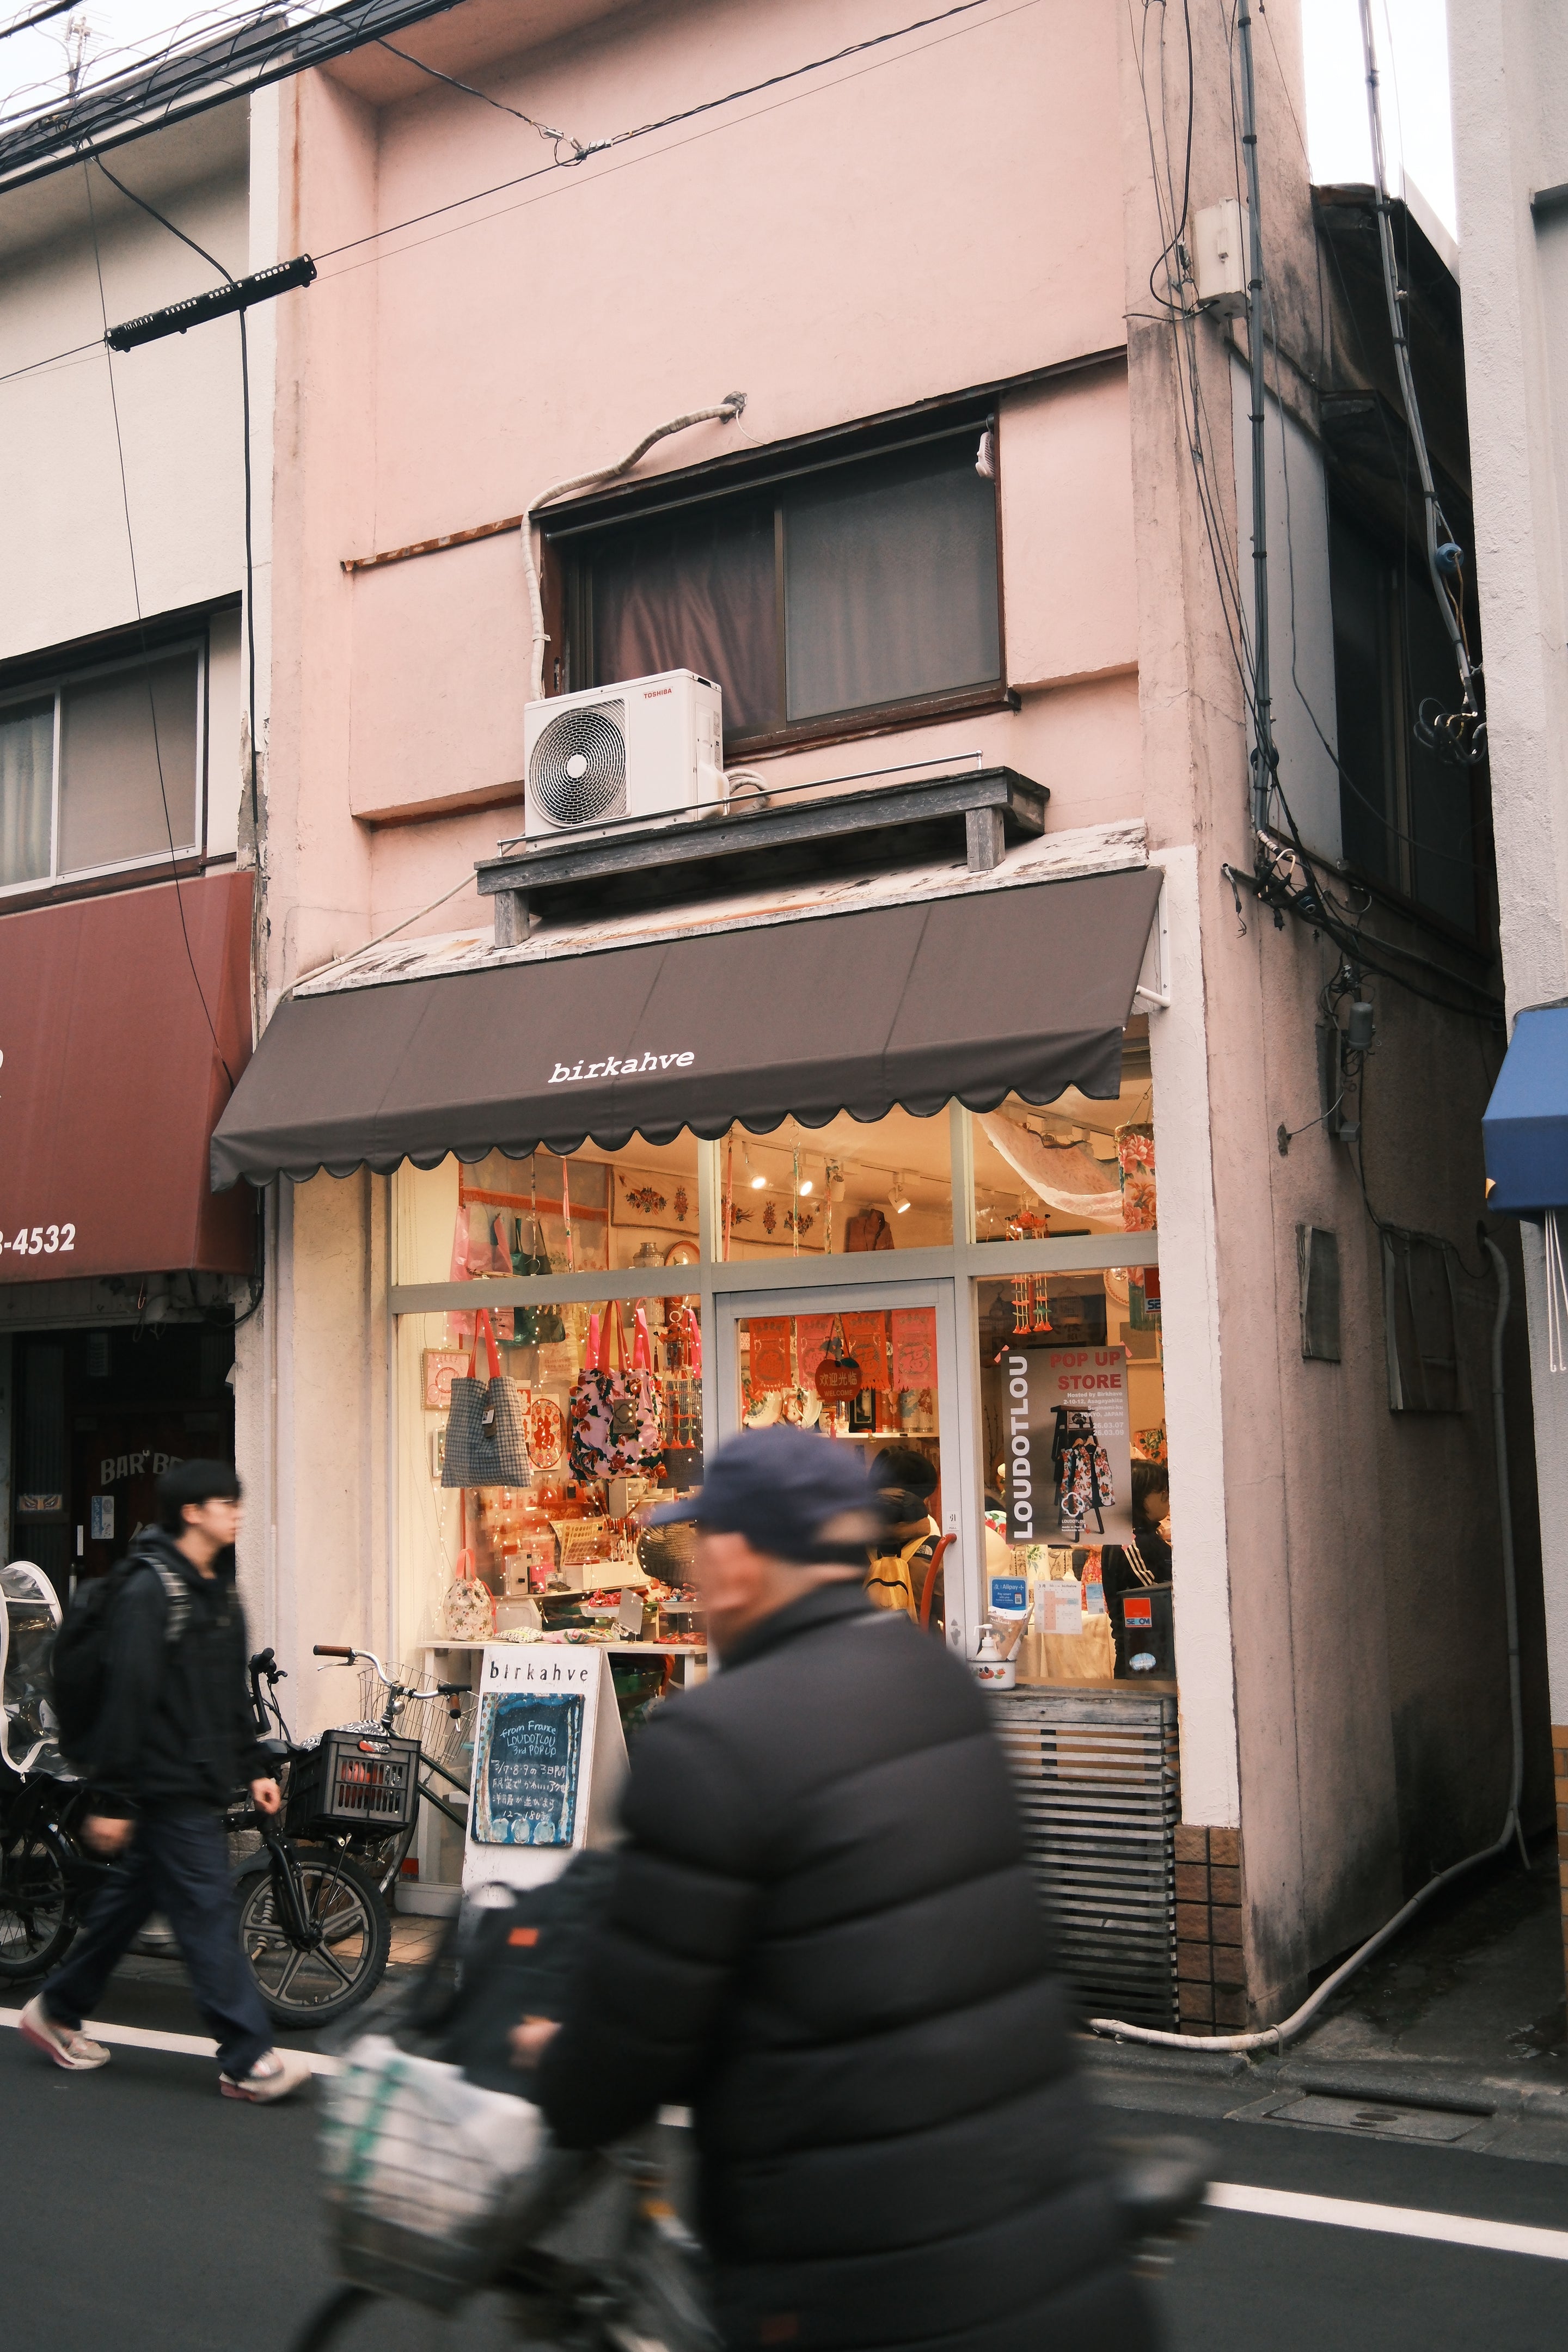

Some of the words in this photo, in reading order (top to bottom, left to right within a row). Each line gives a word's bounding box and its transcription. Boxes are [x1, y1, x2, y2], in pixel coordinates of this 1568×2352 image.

[644, 688, 672, 699] TOSHIBA
[548, 1051, 695, 1083] birkahve
[1050, 1352, 1088, 1368] POP
[1095, 1351, 1120, 1366] UP
[819, 1371, 857, 1387] 欢迎光临
[1058, 1374, 1122, 1390] STORE
[534, 1415, 555, 1450] 福
[1009, 1356, 1033, 1538] LOUDOTLOU
[100, 1453, 145, 1486] BAR
[950, 1514, 956, 1522] 引
[489, 1661, 589, 1682] birkahve
[500, 1724, 524, 1738] from
[528, 1720, 556, 1735] France
[507, 1733, 555, 1748] LOUDOTLOU
[513, 1745, 526, 1756] 3rd
